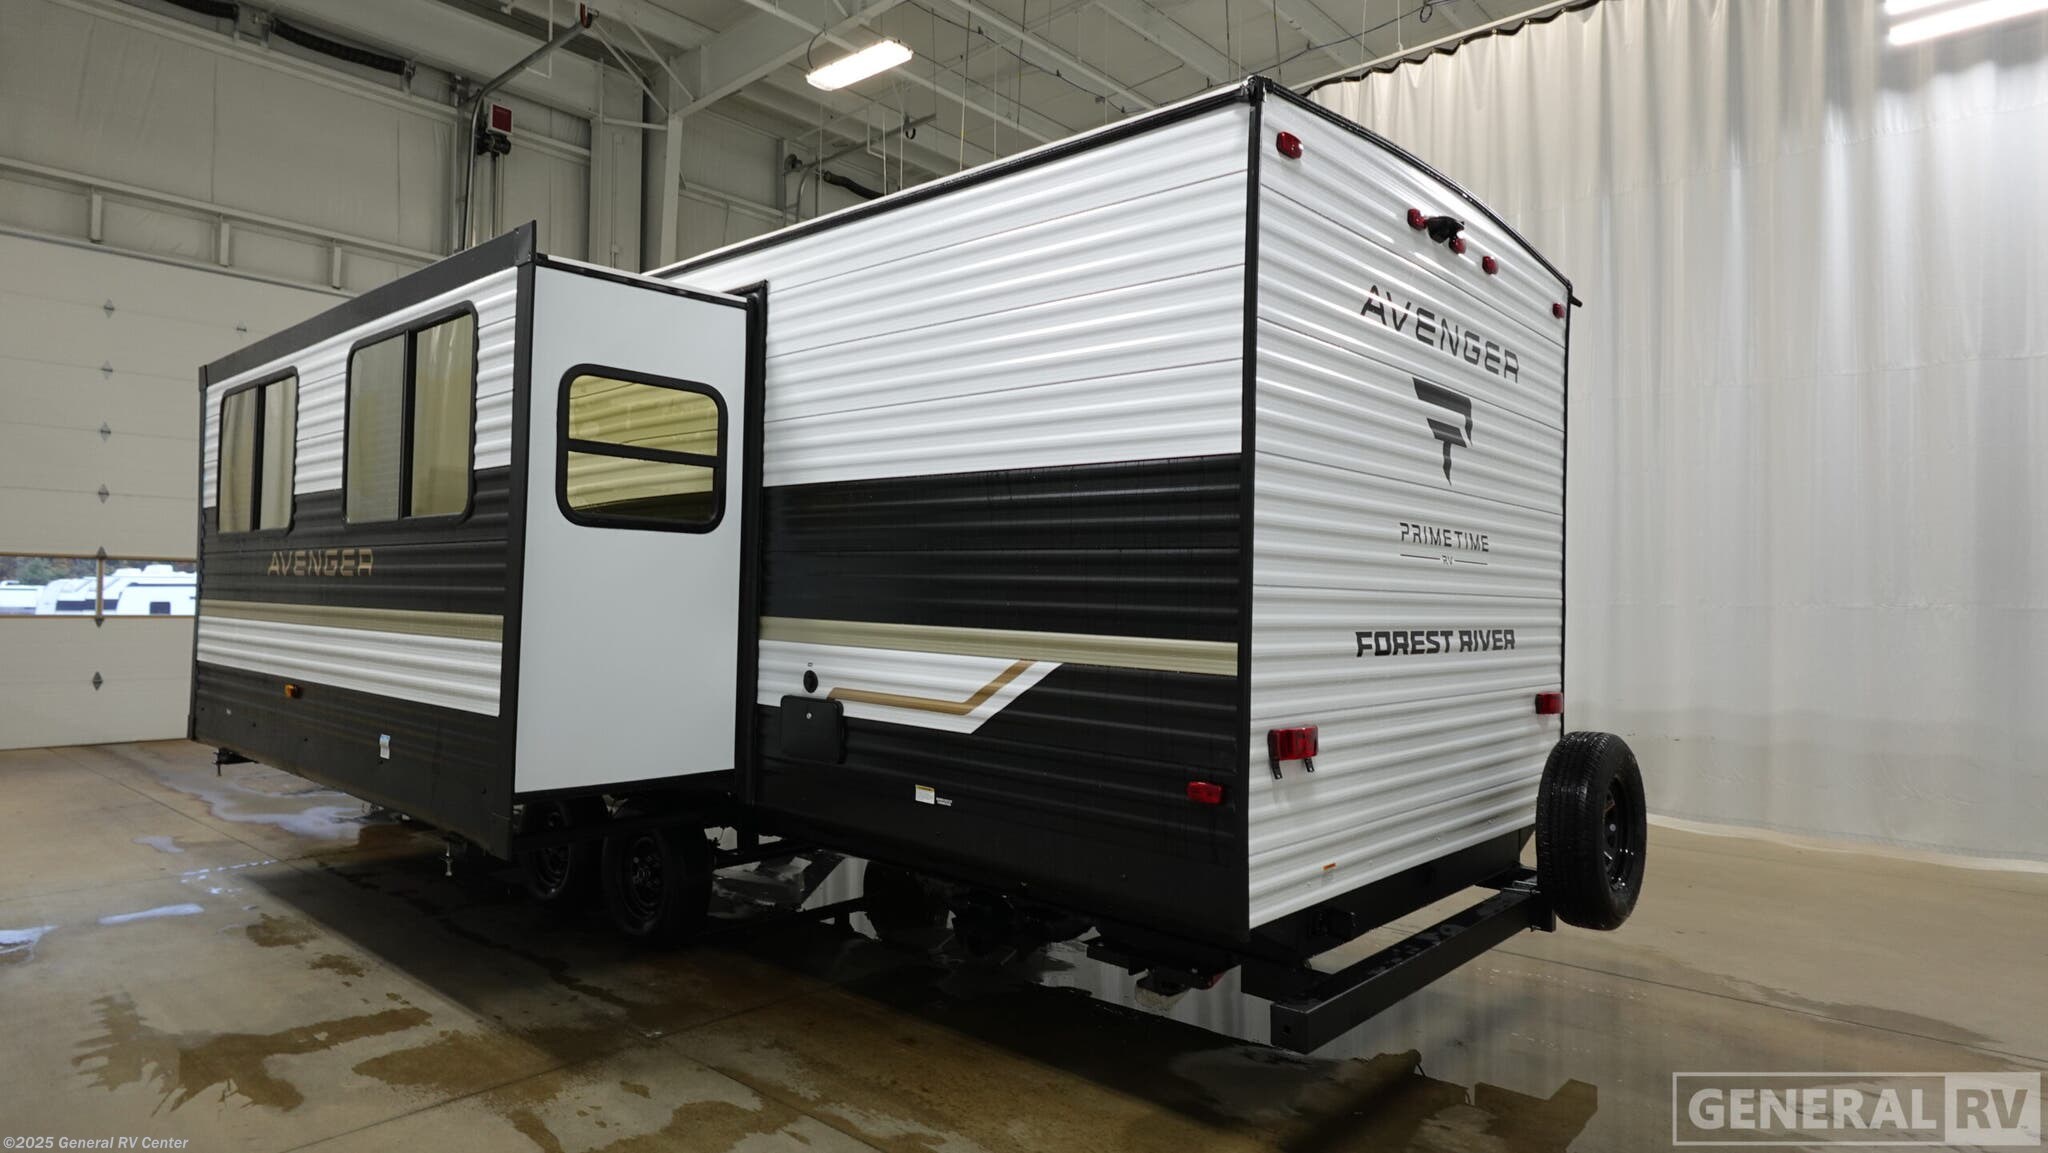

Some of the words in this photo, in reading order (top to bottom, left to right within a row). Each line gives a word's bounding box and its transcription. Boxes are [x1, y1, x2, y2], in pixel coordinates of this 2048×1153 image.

[1360, 284, 1520, 384] AVENGER
[1399, 522, 1490, 553] PRIMETIME
[266, 548, 374, 577] AVENGER
[1441, 555, 1454, 566] RV
[1355, 630, 1454, 658] FOREST
[1458, 629, 1516, 653] RIVER
